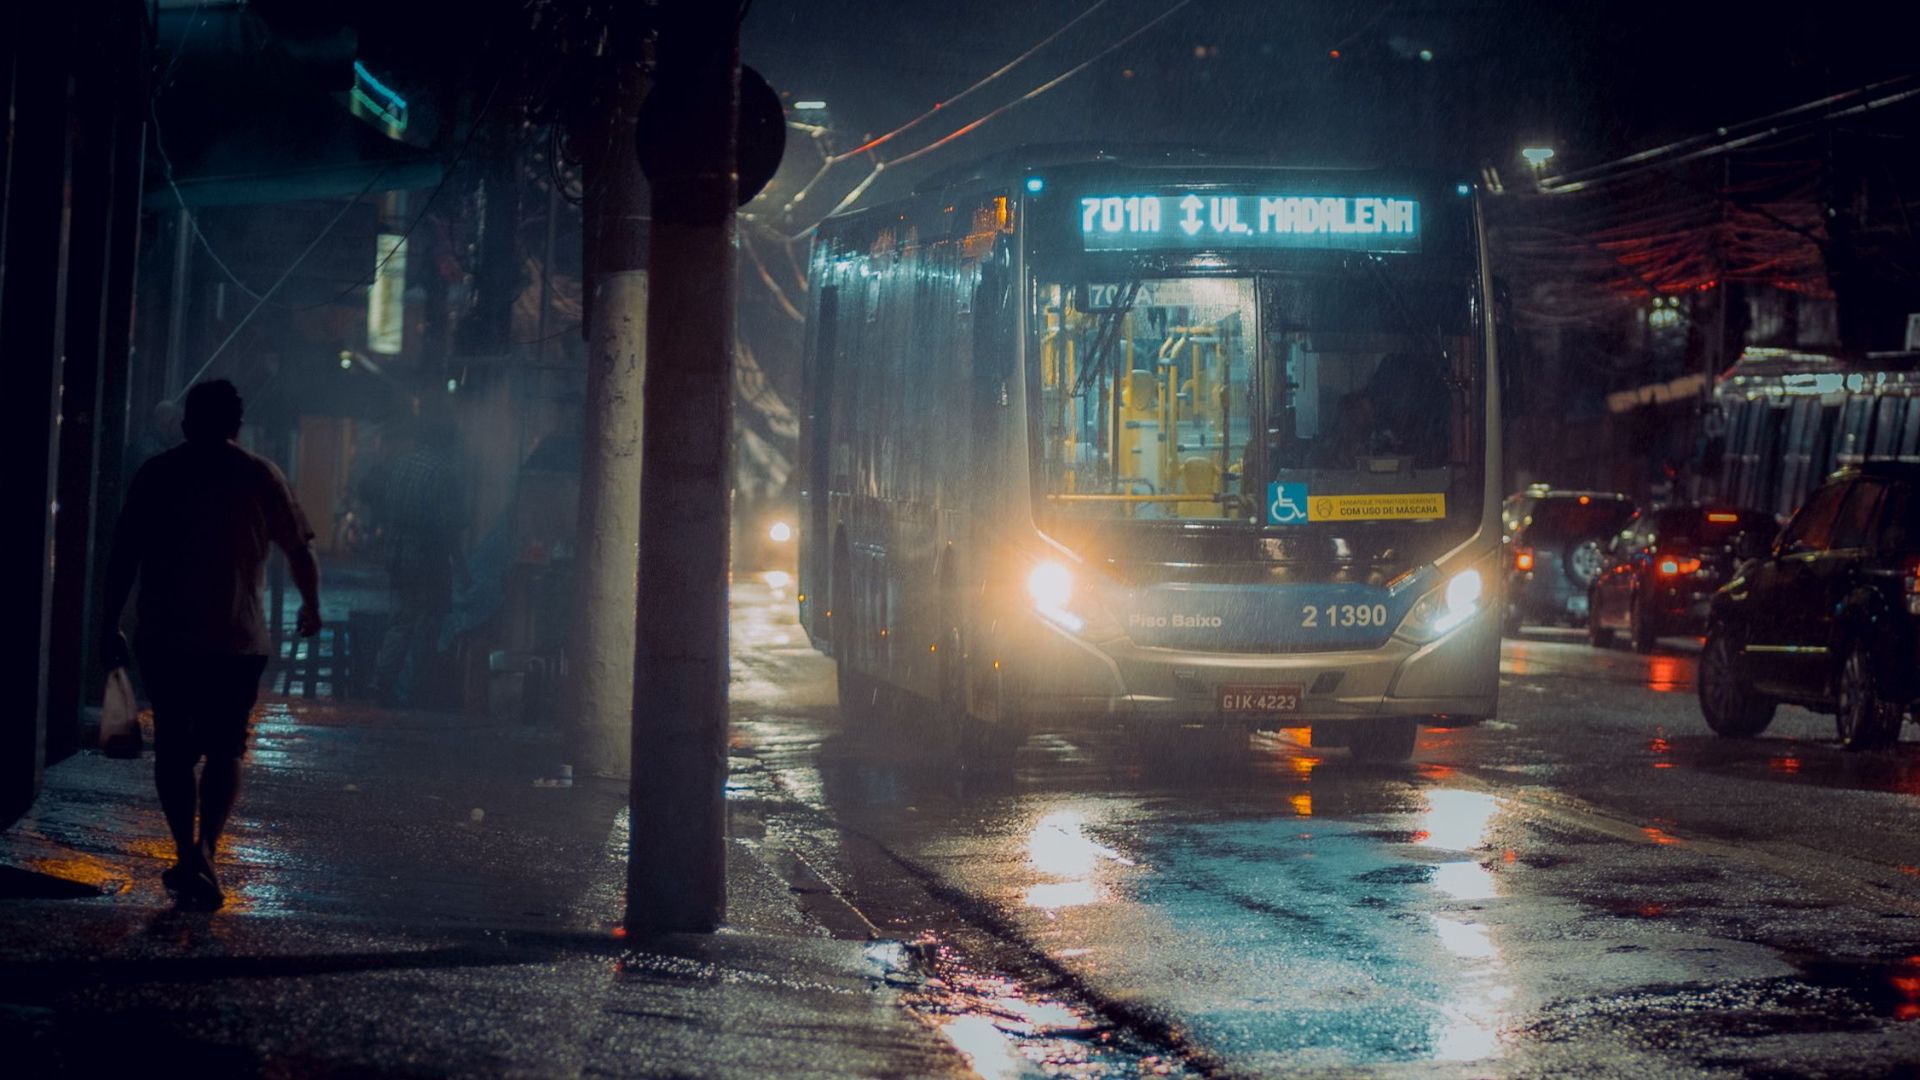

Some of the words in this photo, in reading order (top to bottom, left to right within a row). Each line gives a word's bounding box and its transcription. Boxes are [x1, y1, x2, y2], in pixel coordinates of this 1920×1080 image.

[1081, 197, 1160, 233] 701A
[1210, 198, 1254, 236] VL.
[1259, 197, 1415, 233] MADALENA
[1340, 507, 1361, 516] COM
[1363, 506, 1381, 515] USO
[1383, 506, 1393, 514] DE
[1128, 614, 1167, 628] Piso
[1172, 614, 1222, 628] Baixo
[1301, 605, 1317, 627] 2
[1325, 604, 1387, 627] 1390
